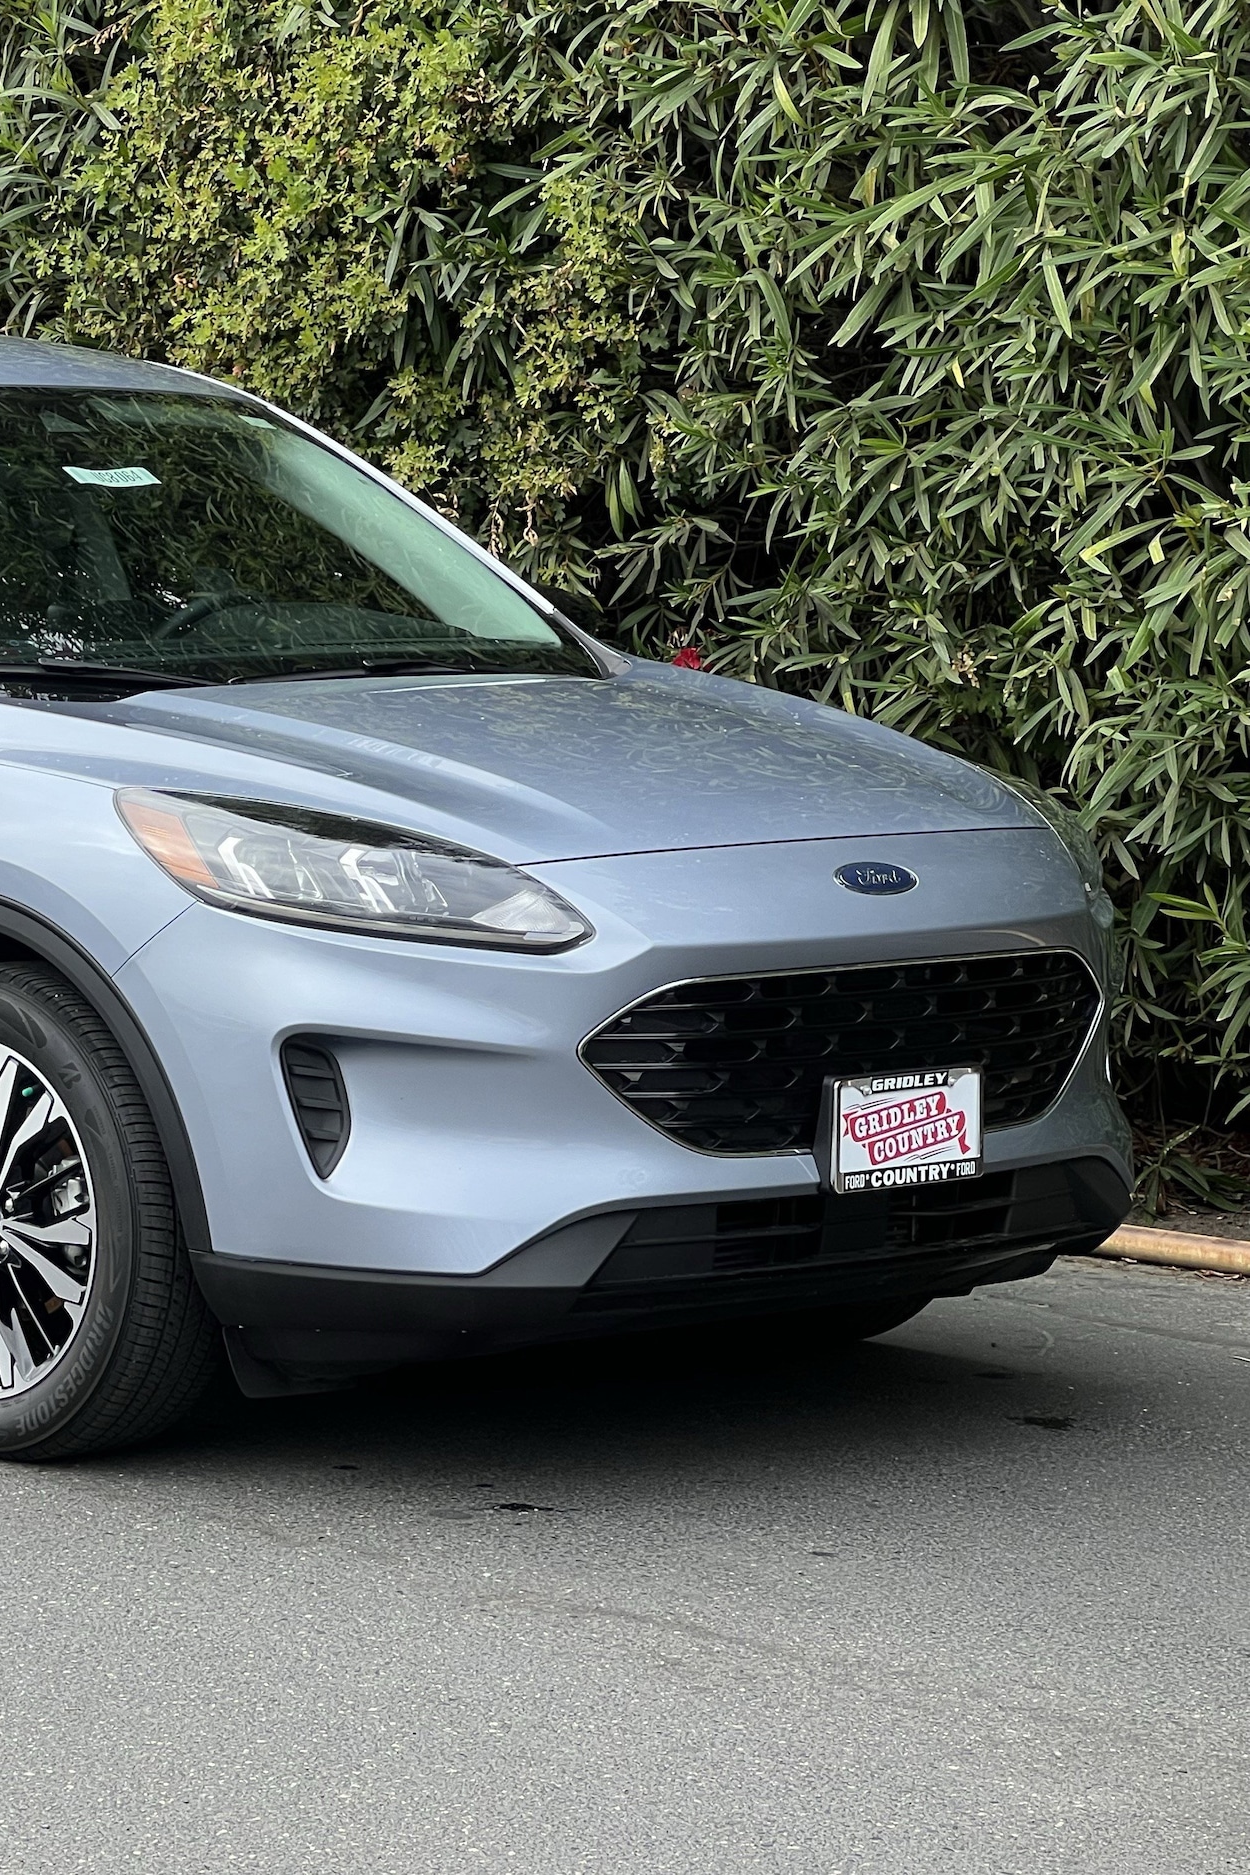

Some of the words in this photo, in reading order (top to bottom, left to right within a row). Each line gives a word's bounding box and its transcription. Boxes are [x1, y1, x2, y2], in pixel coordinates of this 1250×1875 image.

[855, 867, 899, 886] Ford
[871, 1072, 948, 1092] GRIDLEY
[854, 1094, 941, 1138] GRIDLEY
[873, 1114, 960, 1162] COUNTRY
[845, 1173, 865, 1190] FORD
[870, 1162, 951, 1187] COUNTRY
[956, 1160, 976, 1176] FORD
[14, 1298, 115, 1438] BRIDGESTONE
